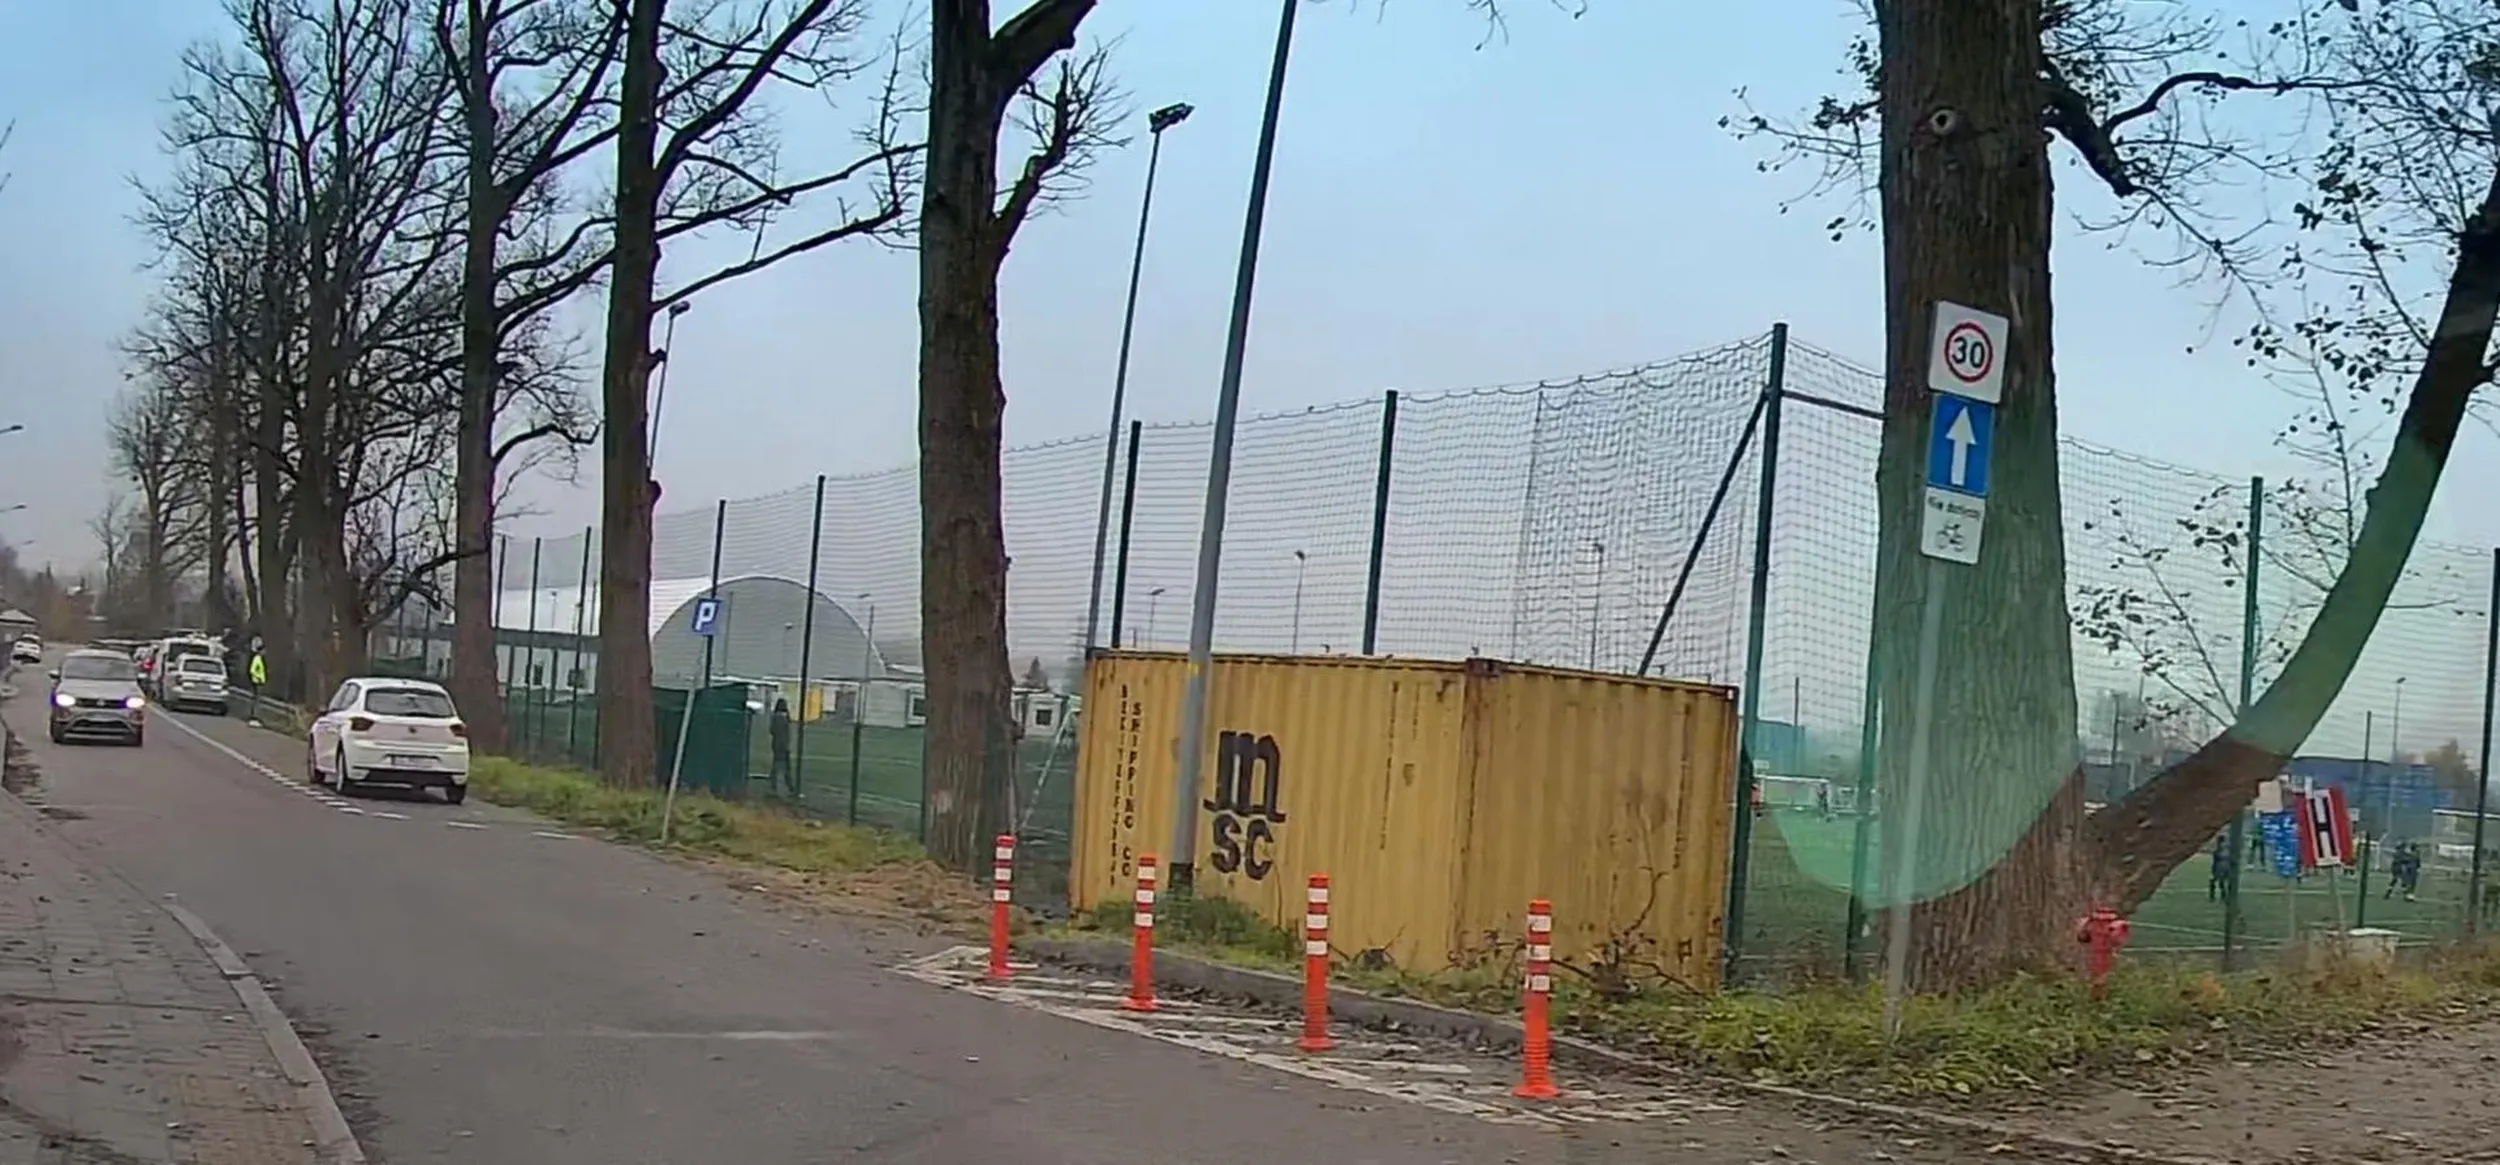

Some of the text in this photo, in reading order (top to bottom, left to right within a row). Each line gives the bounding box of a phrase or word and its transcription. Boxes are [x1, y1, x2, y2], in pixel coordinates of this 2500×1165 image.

[1951, 336, 1986, 370] 30
[695, 601, 717, 631] P
[1210, 813, 1275, 881] SC
[2310, 796, 2338, 858] H
